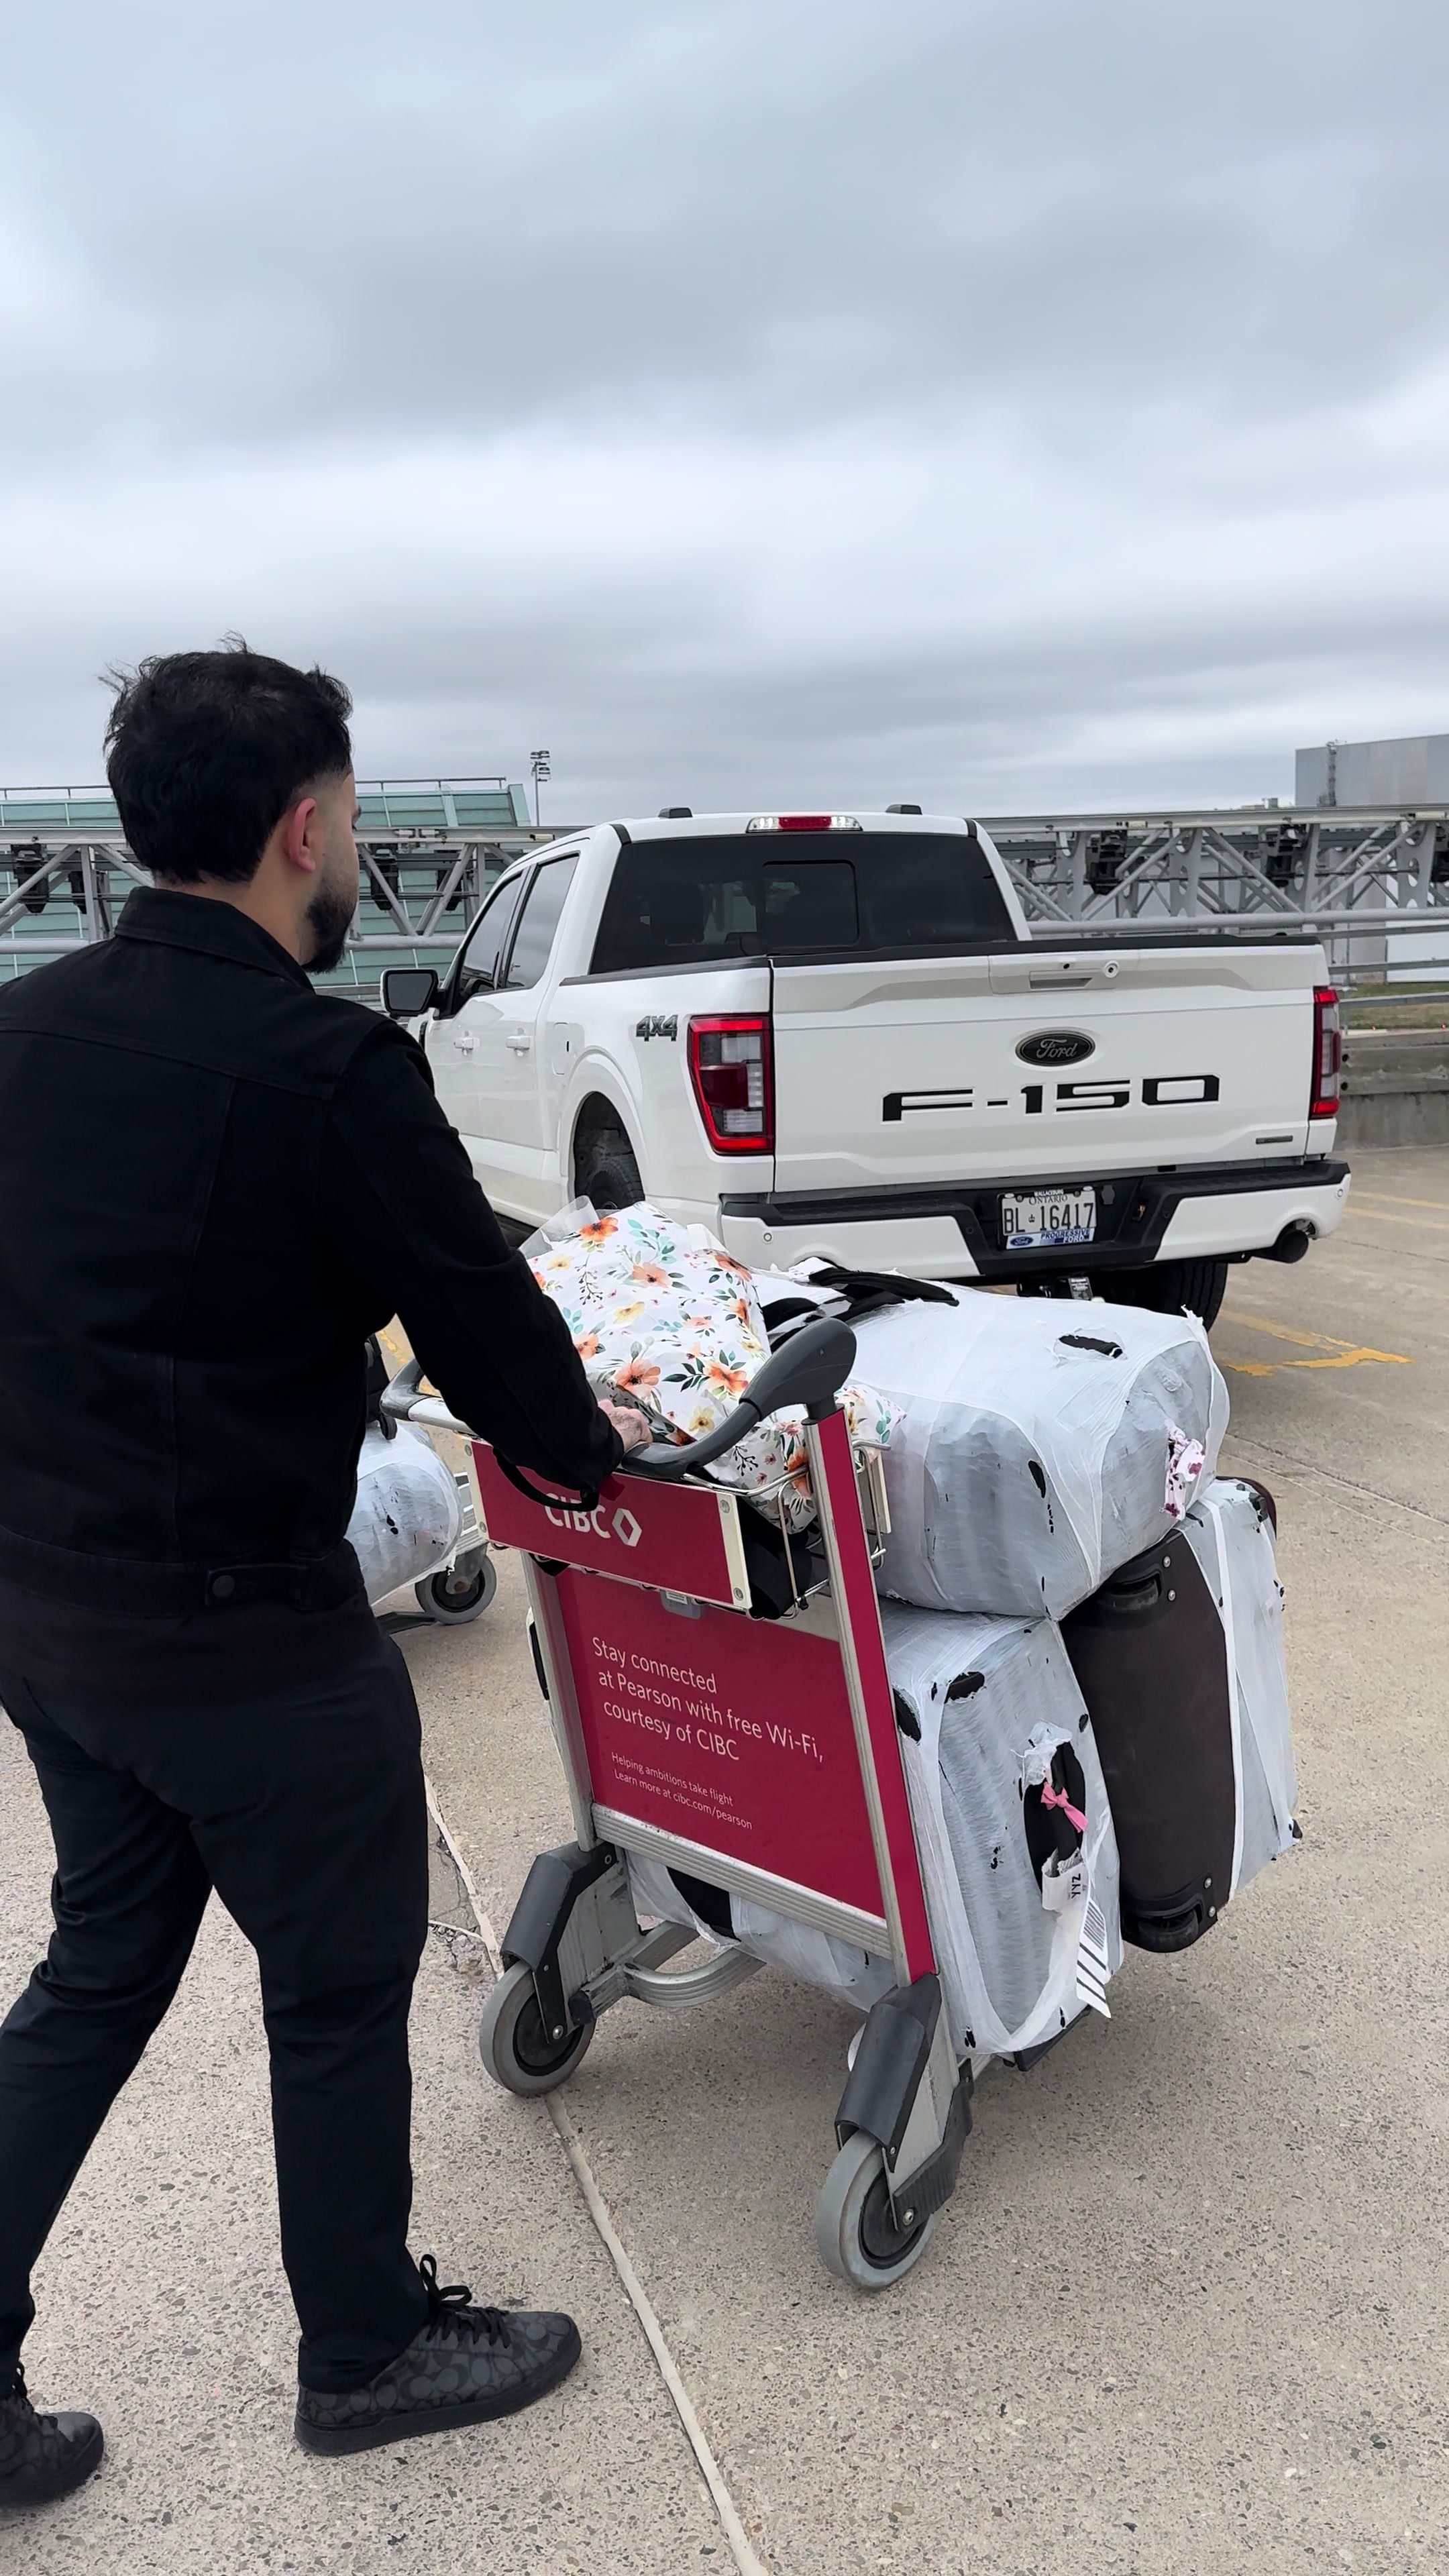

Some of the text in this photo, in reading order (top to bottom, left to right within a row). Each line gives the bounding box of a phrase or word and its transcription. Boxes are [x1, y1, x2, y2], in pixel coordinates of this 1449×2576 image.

[1036, 1038, 1077, 1061] Ford
[882, 1074, 1220, 1122] F-150
[1004, 1203, 1093, 1234] BL 16417
[1040, 1228, 1091, 1239] PROGRESSIVE
[1063, 1235, 1085, 1244] FORD
[545, 1493, 611, 1539] CIBC
[592, 1637, 717, 1695] Stay connected
[598, 1670, 824, 1763] at Pearson with free Wi-Fi,
[604, 1701, 739, 1761] courtesy of CIBC
[611, 1752, 733, 1807] Helping ambitions take flight
[614, 1768, 753, 1830] Learn more at cibc.com/pearson
[1071, 1873, 1081, 1900] YYZ
